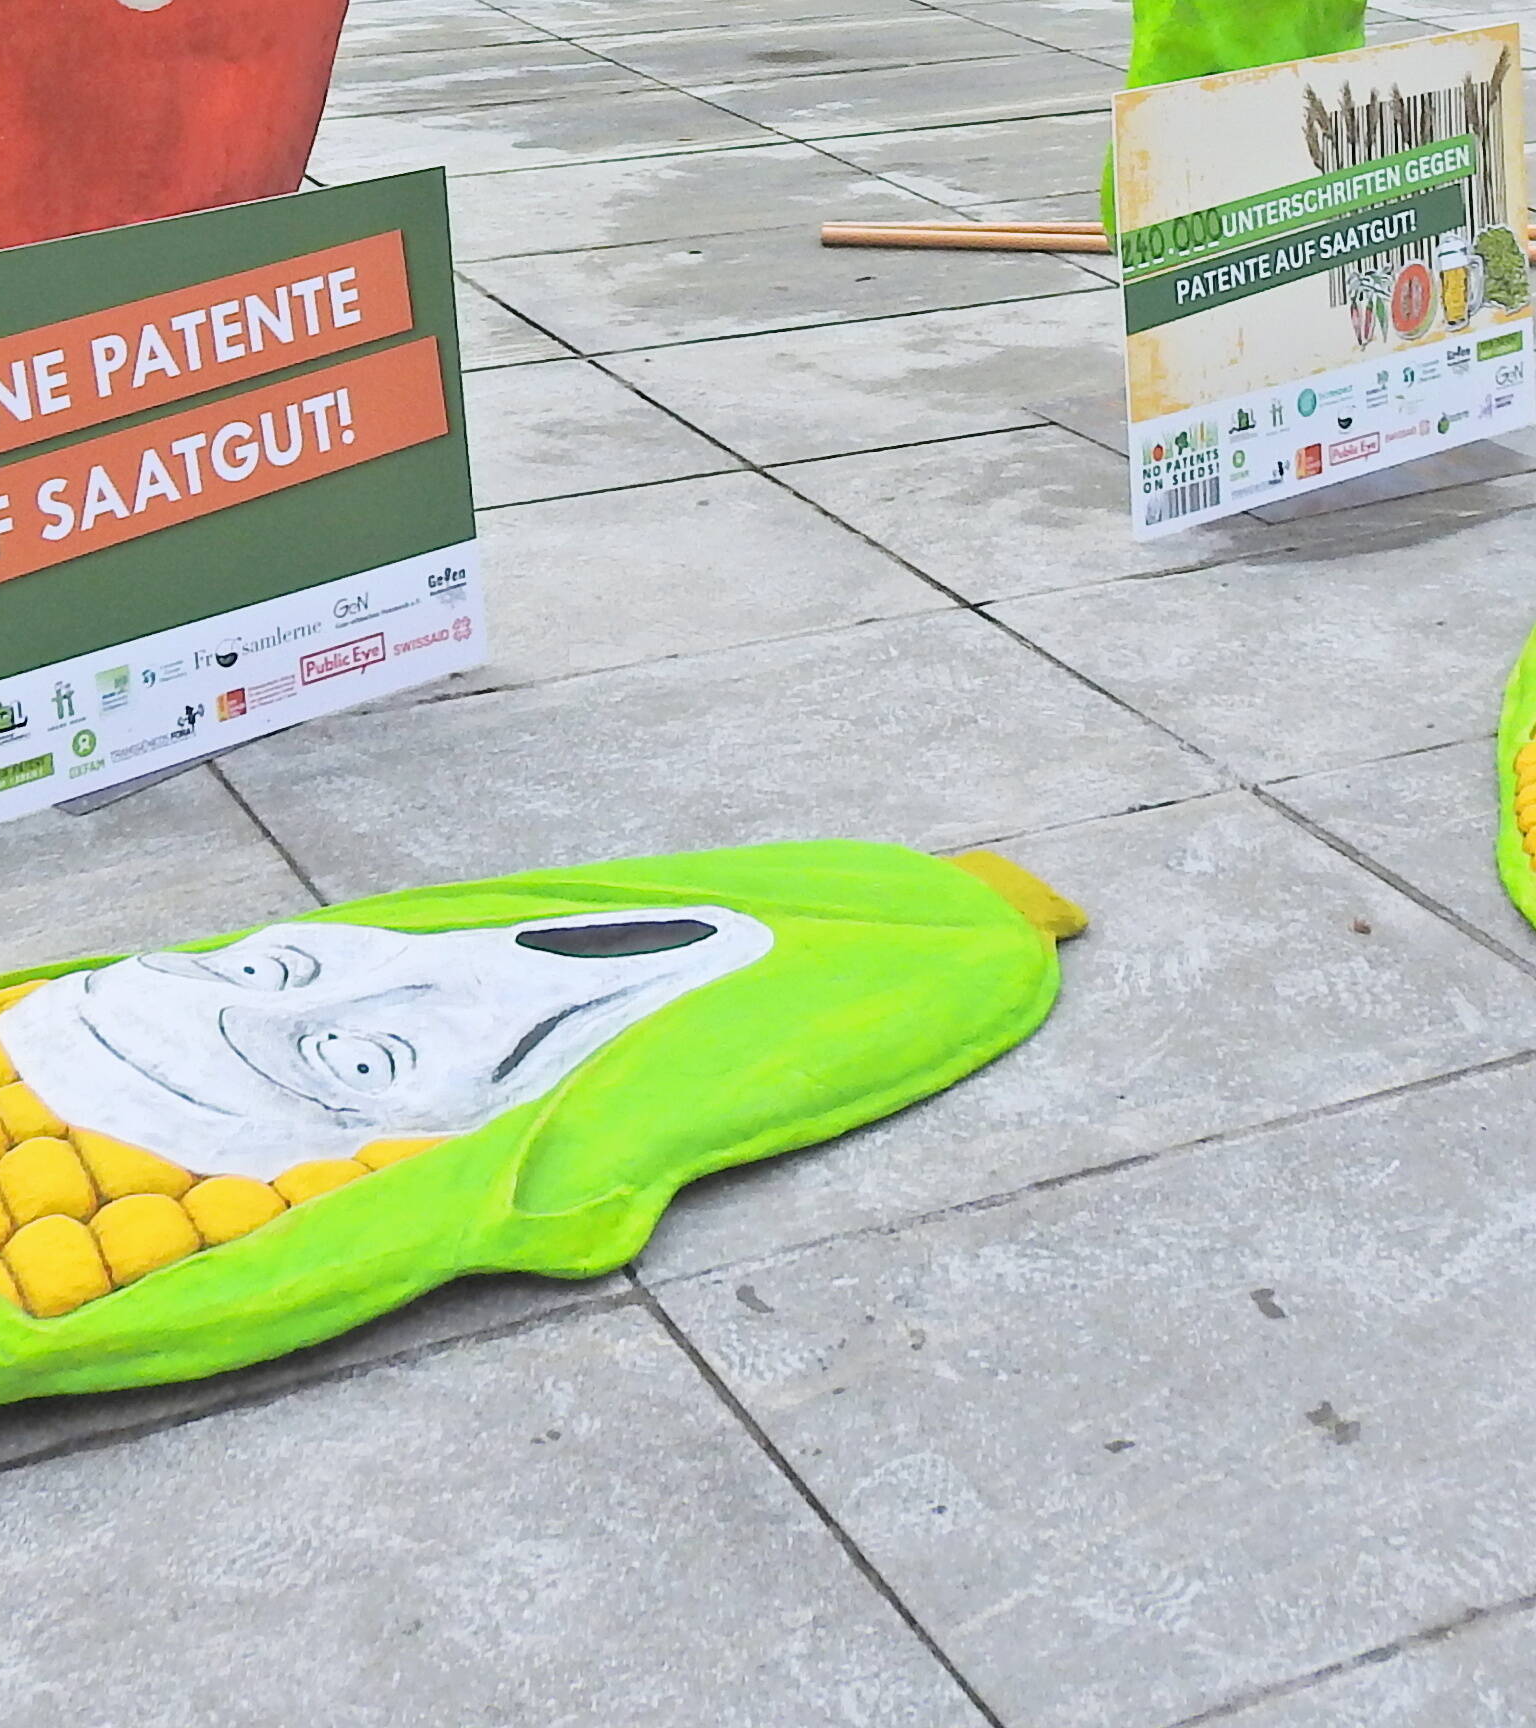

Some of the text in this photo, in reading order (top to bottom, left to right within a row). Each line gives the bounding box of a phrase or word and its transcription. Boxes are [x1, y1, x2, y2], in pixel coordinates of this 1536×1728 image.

[1222, 144, 1471, 239] UNTERSCHRIFTEN GEGEN
[1175, 208, 1418, 306] PATENTE AUF SAATGUT!
[91, 267, 363, 399] PATENTE
[36, 387, 357, 542] SAATGUT!
[1142, 465, 1162, 481] NO
[1166, 448, 1220, 475] PATENTS
[1143, 478, 1164, 494] ON
[1172, 462, 1221, 487] SEEDS!
[306, 652, 351, 678] Public
